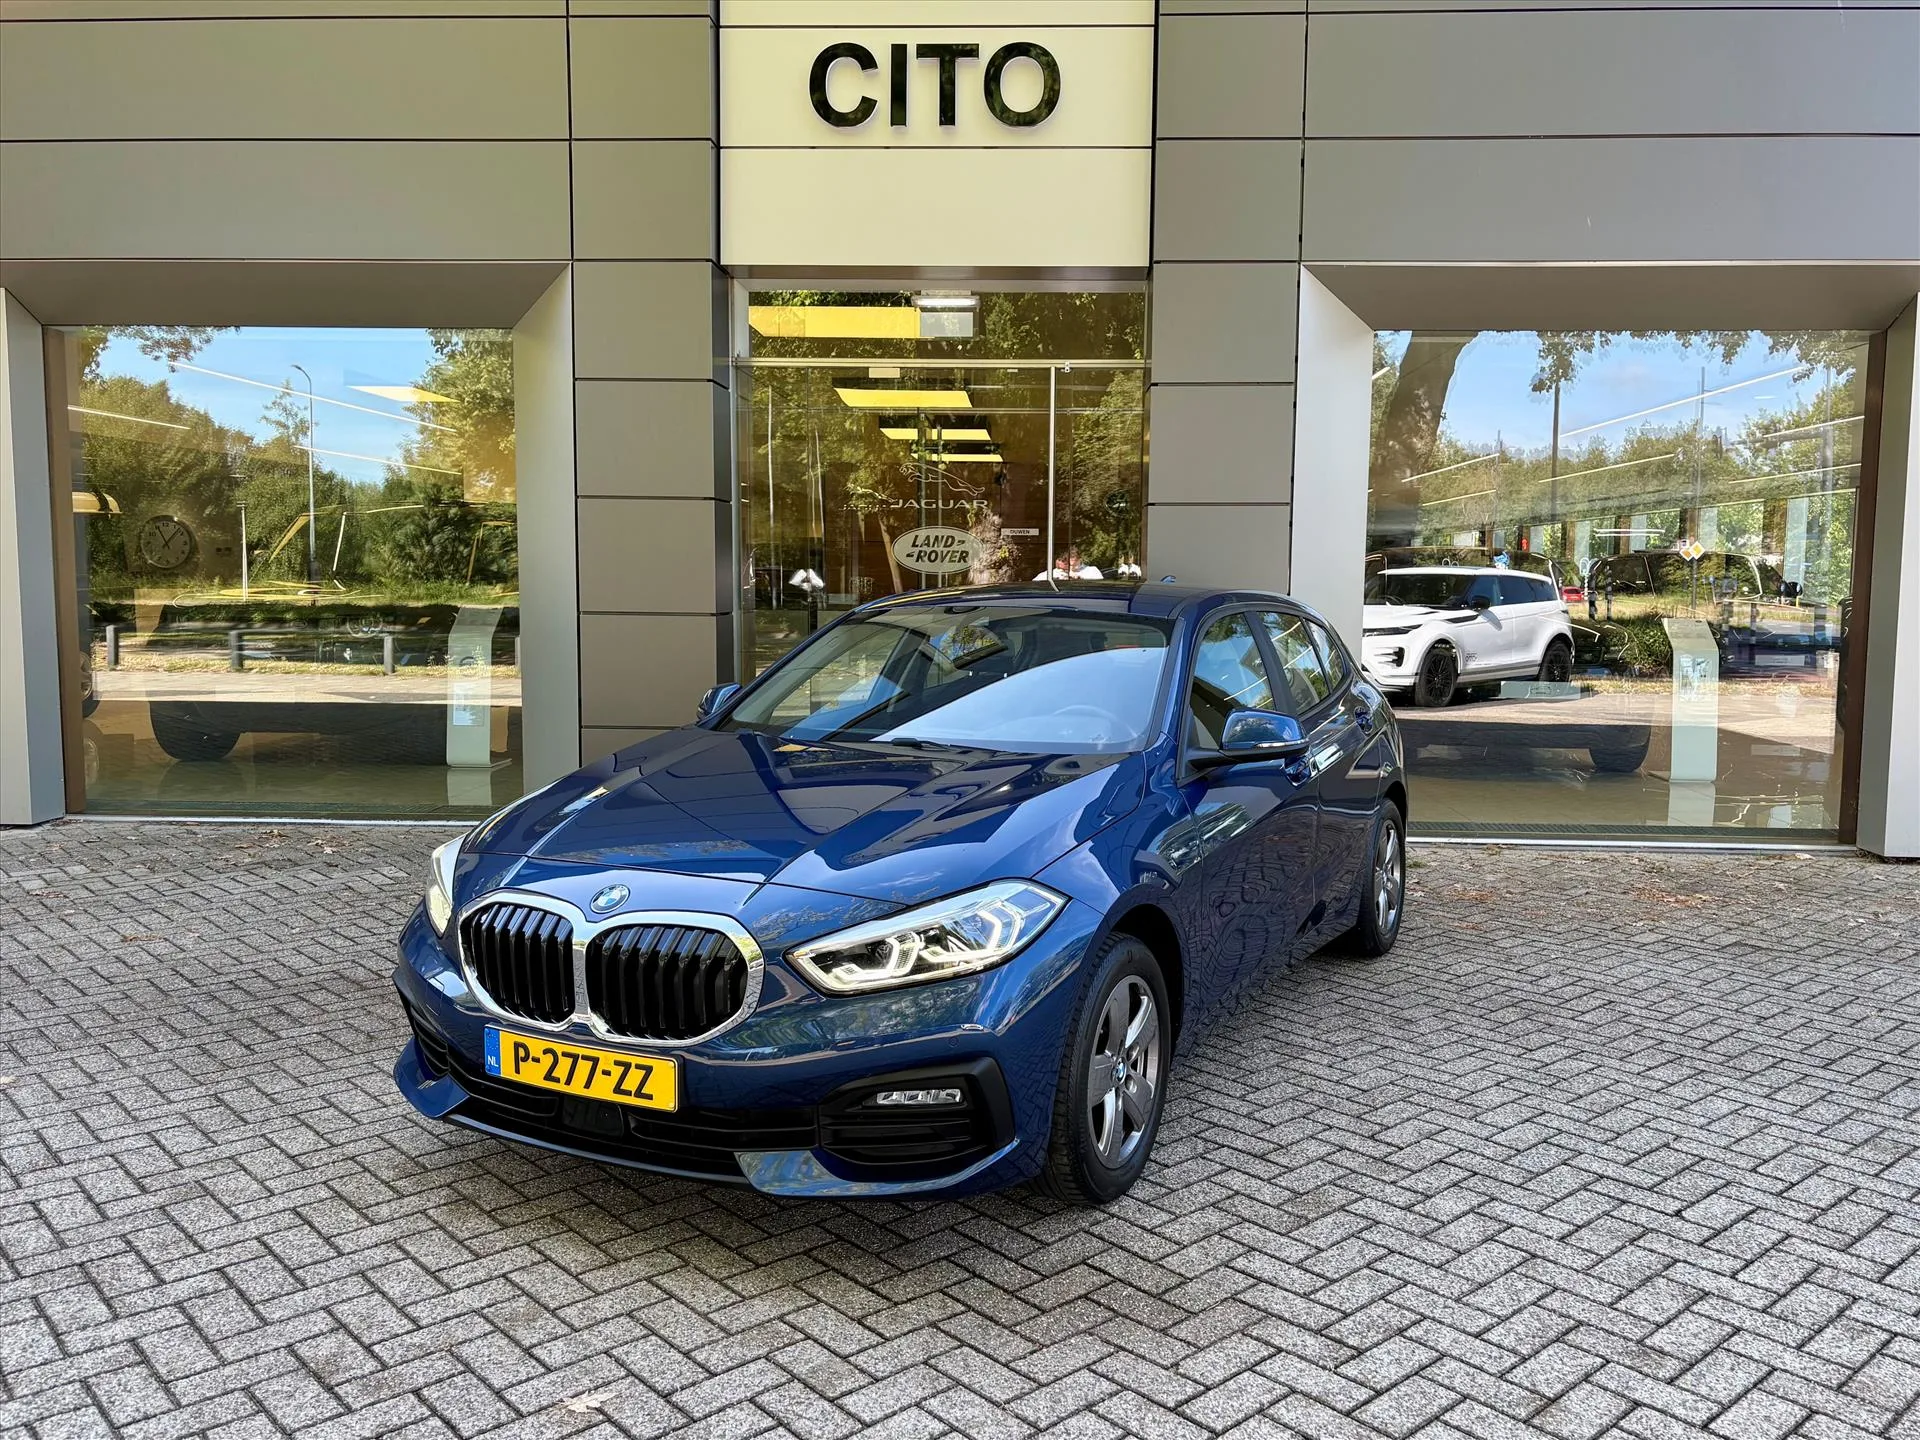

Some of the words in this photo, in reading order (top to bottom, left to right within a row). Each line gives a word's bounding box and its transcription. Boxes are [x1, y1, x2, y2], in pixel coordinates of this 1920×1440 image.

[808, 42, 1062, 128] CITO
[889, 499, 989, 510] JAGUAR
[914, 550, 970, 564] ROVER
[487, 1054, 499, 1068] NL
[513, 1040, 654, 1101] P-277-ZZ
